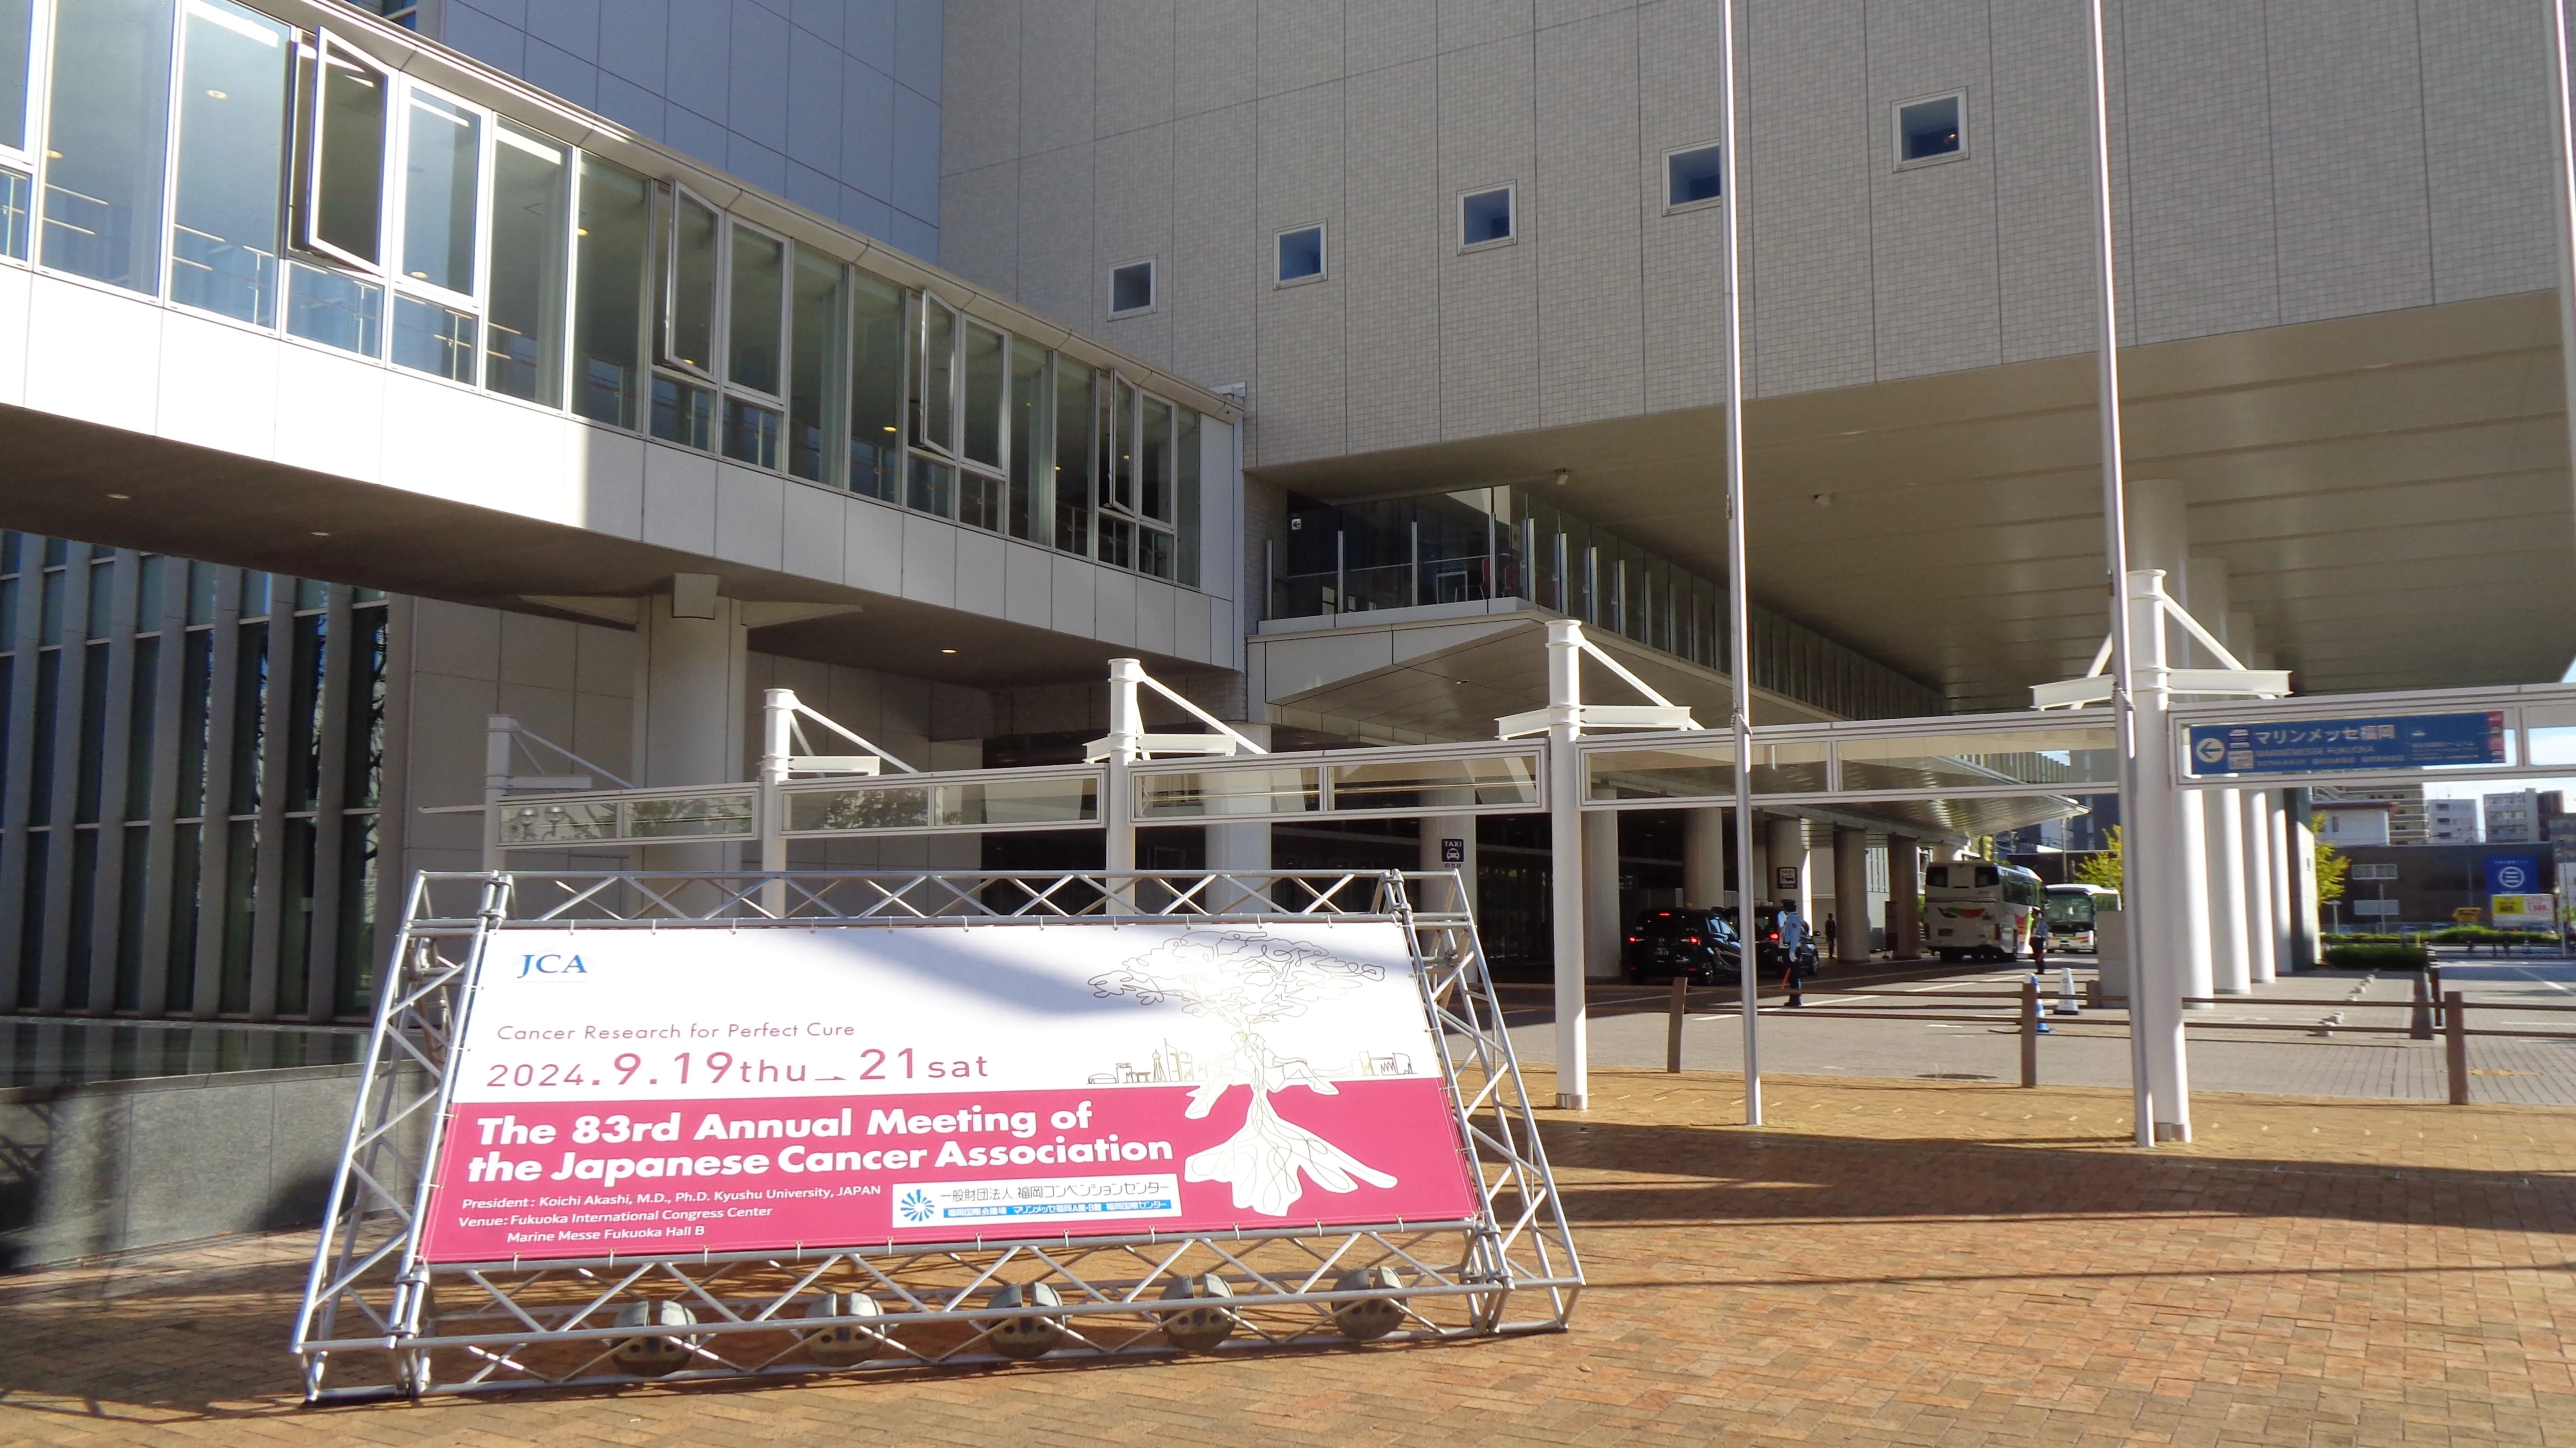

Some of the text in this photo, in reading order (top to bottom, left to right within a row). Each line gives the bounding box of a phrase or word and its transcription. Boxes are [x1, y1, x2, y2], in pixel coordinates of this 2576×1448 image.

[2255, 724, 2395, 745] マリンメッセ福岡
[516, 954, 588, 978] JCA
[498, 1022, 854, 1040] Cancer Research for Perfect Cure
[476, 1100, 1092, 1146] The 83rd Annual Meeting of
[468, 1133, 1174, 1188] the Japanese Cancer Association
[539, 1196, 581, 1207] Koichi
[583, 1194, 632, 1206] Akashi,
[637, 1193, 672, 1204] M.D.,
[675, 1192, 710, 1202] Ph.D.
[714, 1190, 762, 1203] Kyushu
[766, 1188, 834, 1200] University,
[836, 1185, 881, 1196] JAPAN
[940, 1181, 1170, 1202] 一般財団法人 福岡コンベンションセンター
[458, 1208, 773, 1227] Venue: Fukuoka International Congress Center
[506, 1225, 706, 1242] Marine Messe Fukuoka Hall B
